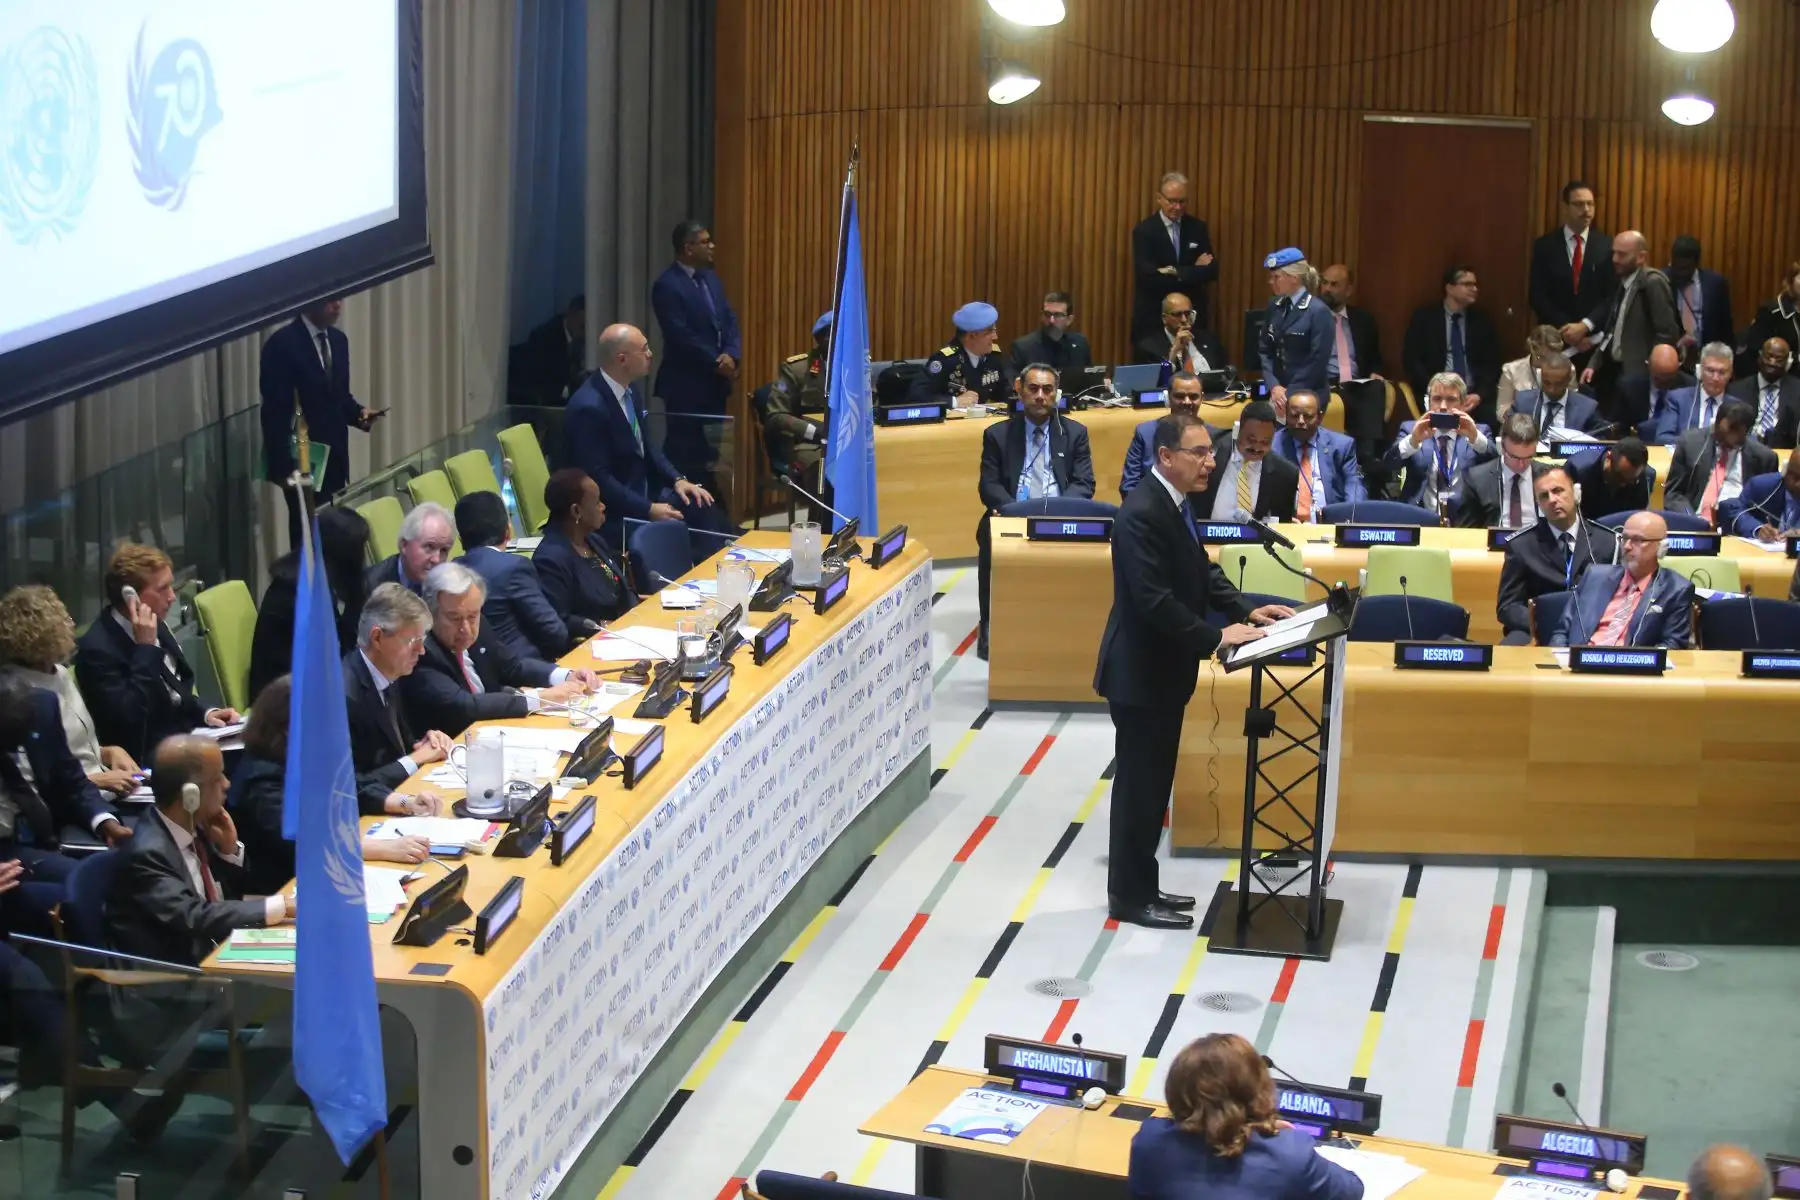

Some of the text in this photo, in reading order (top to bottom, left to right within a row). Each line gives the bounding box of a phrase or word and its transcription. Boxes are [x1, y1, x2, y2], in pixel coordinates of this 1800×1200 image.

[1063, 524, 1077, 534] FIJI
[1207, 526, 1242, 538] ETHIOPIA
[1360, 530, 1396, 541] ESWATINI
[905, 571, 922, 593] ACTION
[876, 595, 894, 616] ACTION
[914, 598, 930, 619] ACTION
[846, 616, 865, 642] ACTION
[887, 619, 904, 642] ACTION
[817, 642, 835, 667] ACTION
[859, 644, 876, 665] ACTION
[905, 638, 921, 660] ACTION
[1423, 648, 1464, 661] RESERVED
[1581, 653, 1655, 665] BOSNIA AND HERZEGOVINA
[787, 671, 805, 695] ACTION
[830, 667, 848, 691] ACTION
[877, 659, 894, 683] ACTION
[801, 693, 819, 720] ACTION
[848, 688, 865, 711] ACTION
[886, 685, 904, 709] ACTION
[754, 699, 776, 727] ACTION
[819, 713, 837, 739] ACTION
[858, 710, 876, 733] ACTION
[722, 728, 742, 757] ACTION
[772, 723, 790, 751] ACTION
[830, 736, 848, 761] ACTION
[740, 752, 760, 782] ACTION
[788, 740, 807, 770] ACTION
[688, 764, 711, 793] ACTION
[758, 774, 777, 803] ACTION
[802, 764, 820, 791] ACTION
[709, 784, 729, 814] ACTION
[772, 794, 791, 824] ACTION
[817, 783, 836, 808] ACTION
[654, 799, 678, 832] ACTION
[725, 805, 745, 838] ACTION
[788, 812, 808, 840] ACTION
[677, 818, 697, 851] ACTION
[741, 827, 761, 857] ACTION
[800, 833, 820, 863] ACTION
[618, 836, 641, 868] ACTION
[693, 841, 713, 874] ACTION
[758, 846, 778, 876] ACTION
[643, 856, 664, 889] ACTION
[711, 861, 730, 894] ACTION
[581, 876, 604, 912] ACTION
[659, 880, 680, 913] ACTION
[725, 883, 745, 911] ACTION
[606, 892, 629, 930] ACTION
[679, 900, 699, 934] ACTION
[740, 900, 762, 931] ACTION
[543, 919, 566, 957] ACTION
[623, 920, 645, 956] ACTION
[694, 921, 713, 953] ACTION
[570, 936, 592, 973] ACTION
[645, 938, 666, 974] ACTION
[502, 966, 527, 1005] ACTION
[585, 962, 607, 1001] ACTION
[661, 961, 682, 994] ACTION
[530, 982, 554, 1020] ACTION
[609, 978, 632, 1017] ACTION
[545, 1009, 568, 1048] ACTION
[622, 1002, 647, 1040] ACTION
[570, 1024, 593, 1063] ACTION
[585, 1048, 608, 1087] ACTION
[1013, 1050, 1092, 1078] AFGHANISTAN
[503, 1059, 528, 1101] ACTION
[531, 1071, 555, 1112] ACTION
[967, 1091, 1040, 1110] ACTION
[1280, 1092, 1331, 1116] ALBANIA
[545, 1097, 568, 1140] ACTION
[1541, 1132, 1595, 1157] ALGERIA
[1510, 1180, 1589, 1198] ACTION
